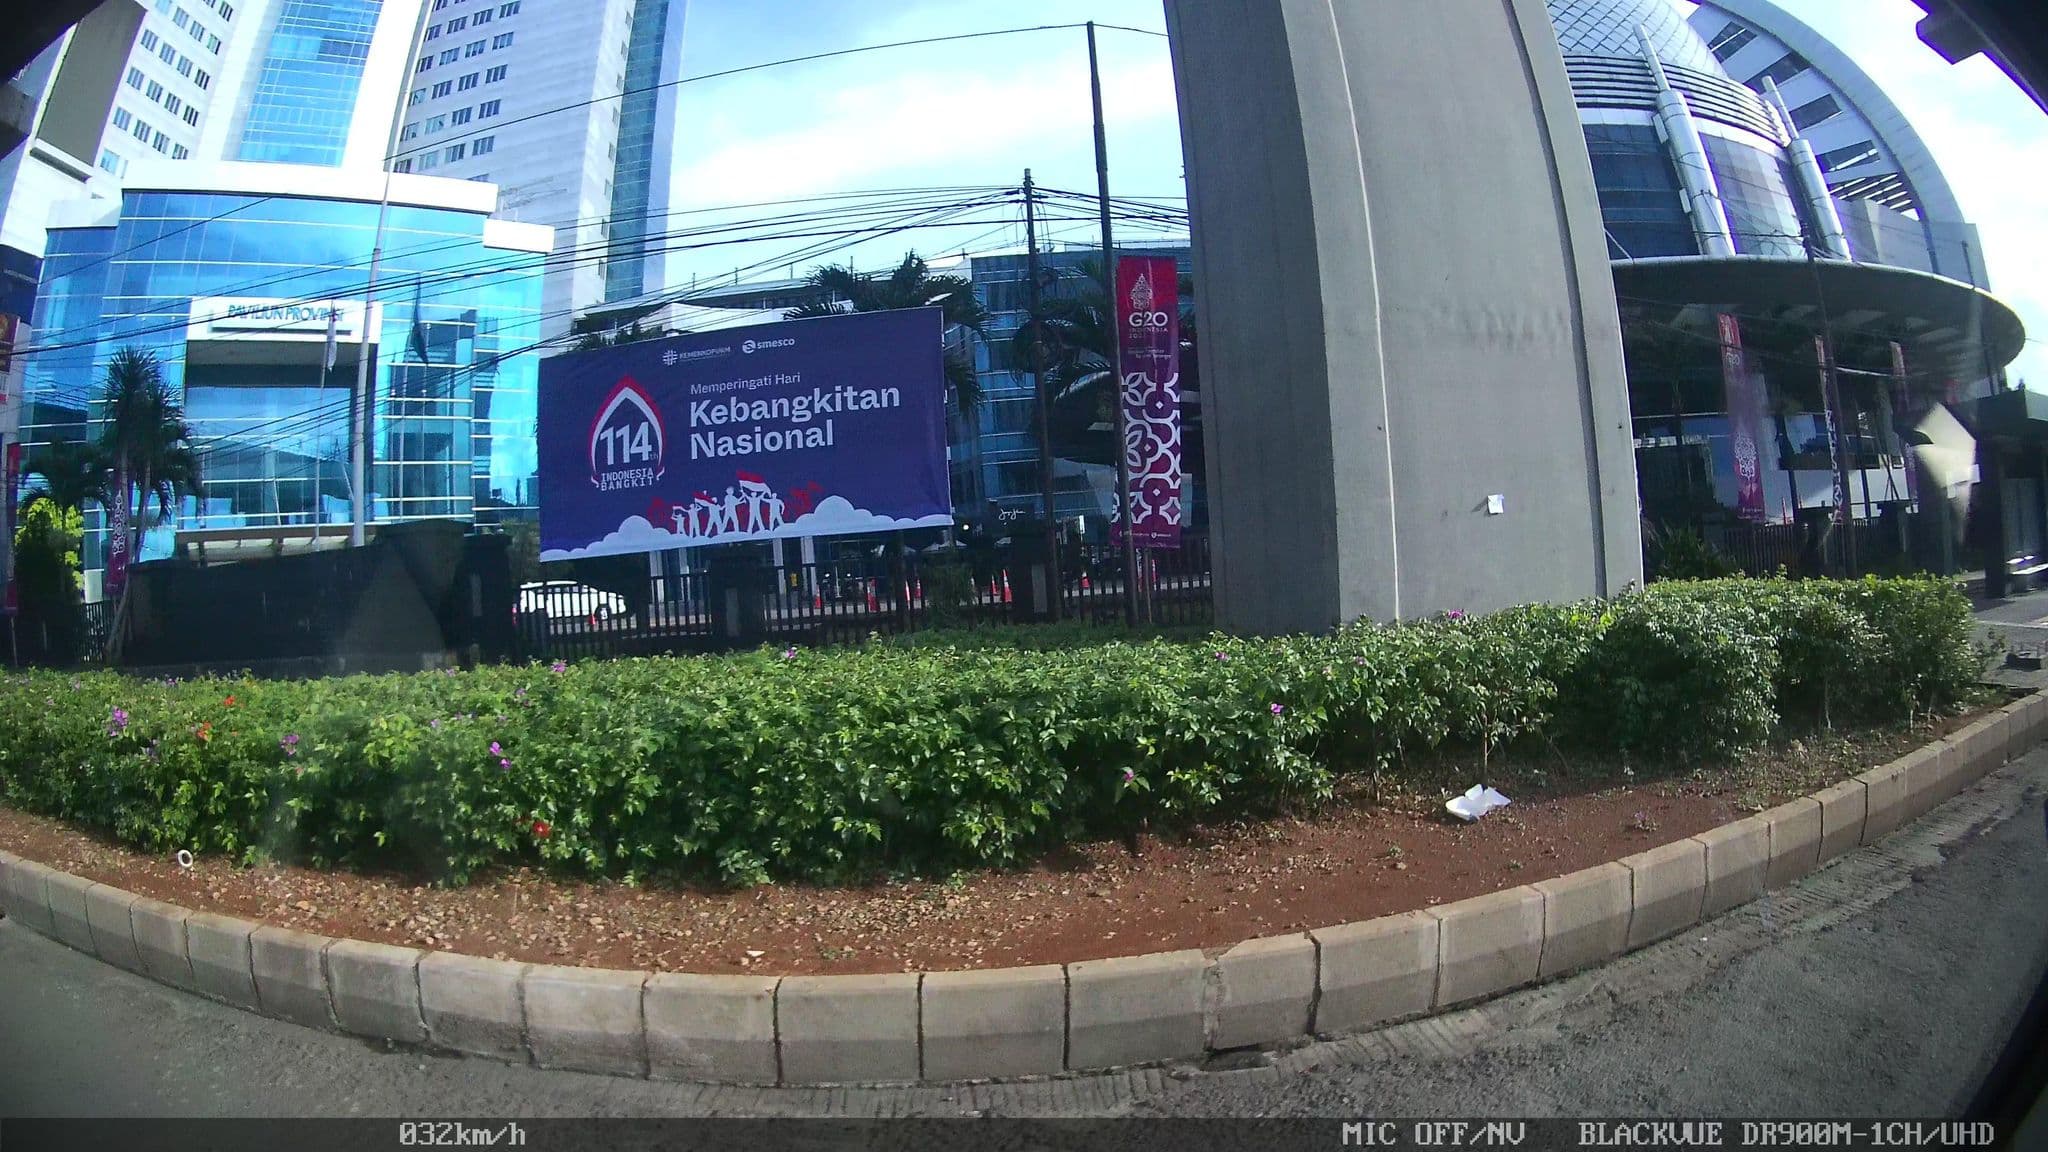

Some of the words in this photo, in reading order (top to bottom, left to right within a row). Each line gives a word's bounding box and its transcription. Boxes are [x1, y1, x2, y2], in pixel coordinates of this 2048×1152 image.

[1128, 311, 1169, 327] G20
[757, 337, 795, 350] smesco
[690, 379, 772, 396] Memperingati
[775, 371, 801, 385] Hari
[690, 386, 900, 428] Kebangkitan
[690, 420, 834, 460] Nasional
[601, 468, 654, 483] INDONESIA
[601, 477, 653, 492] BANGKIT
